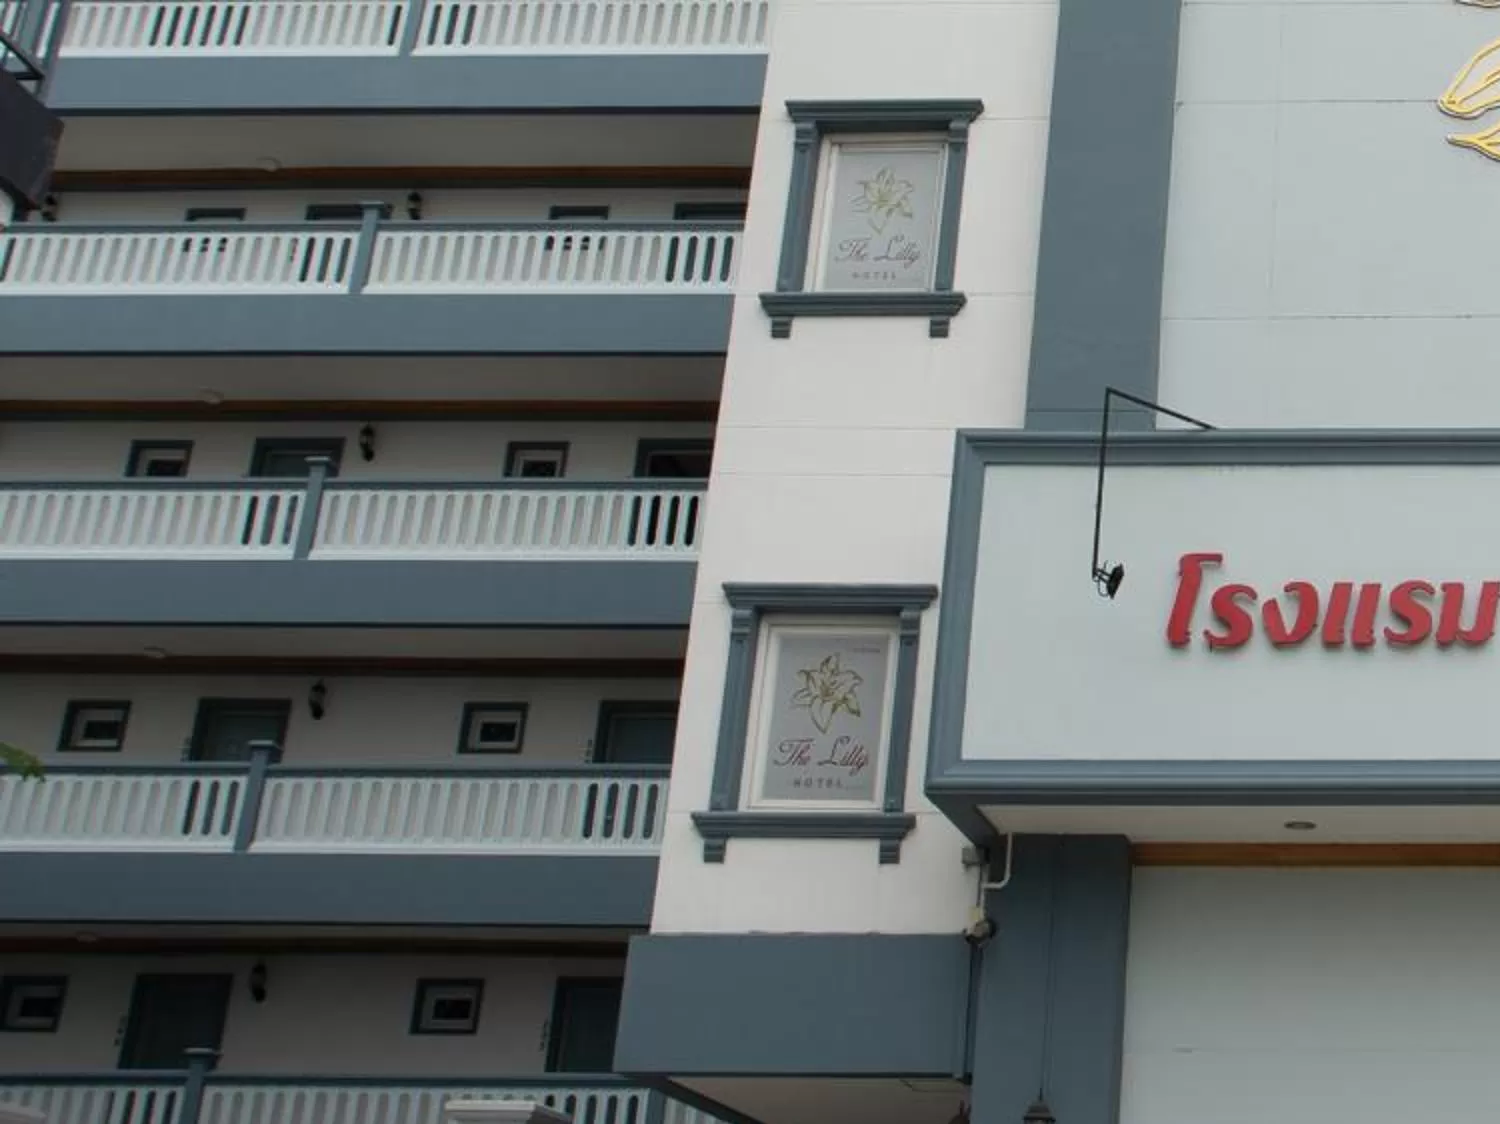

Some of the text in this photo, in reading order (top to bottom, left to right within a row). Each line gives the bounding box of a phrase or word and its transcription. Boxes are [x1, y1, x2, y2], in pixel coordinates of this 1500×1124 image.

[833, 235, 873, 263] The
[772, 735, 869, 777] The Lilly
